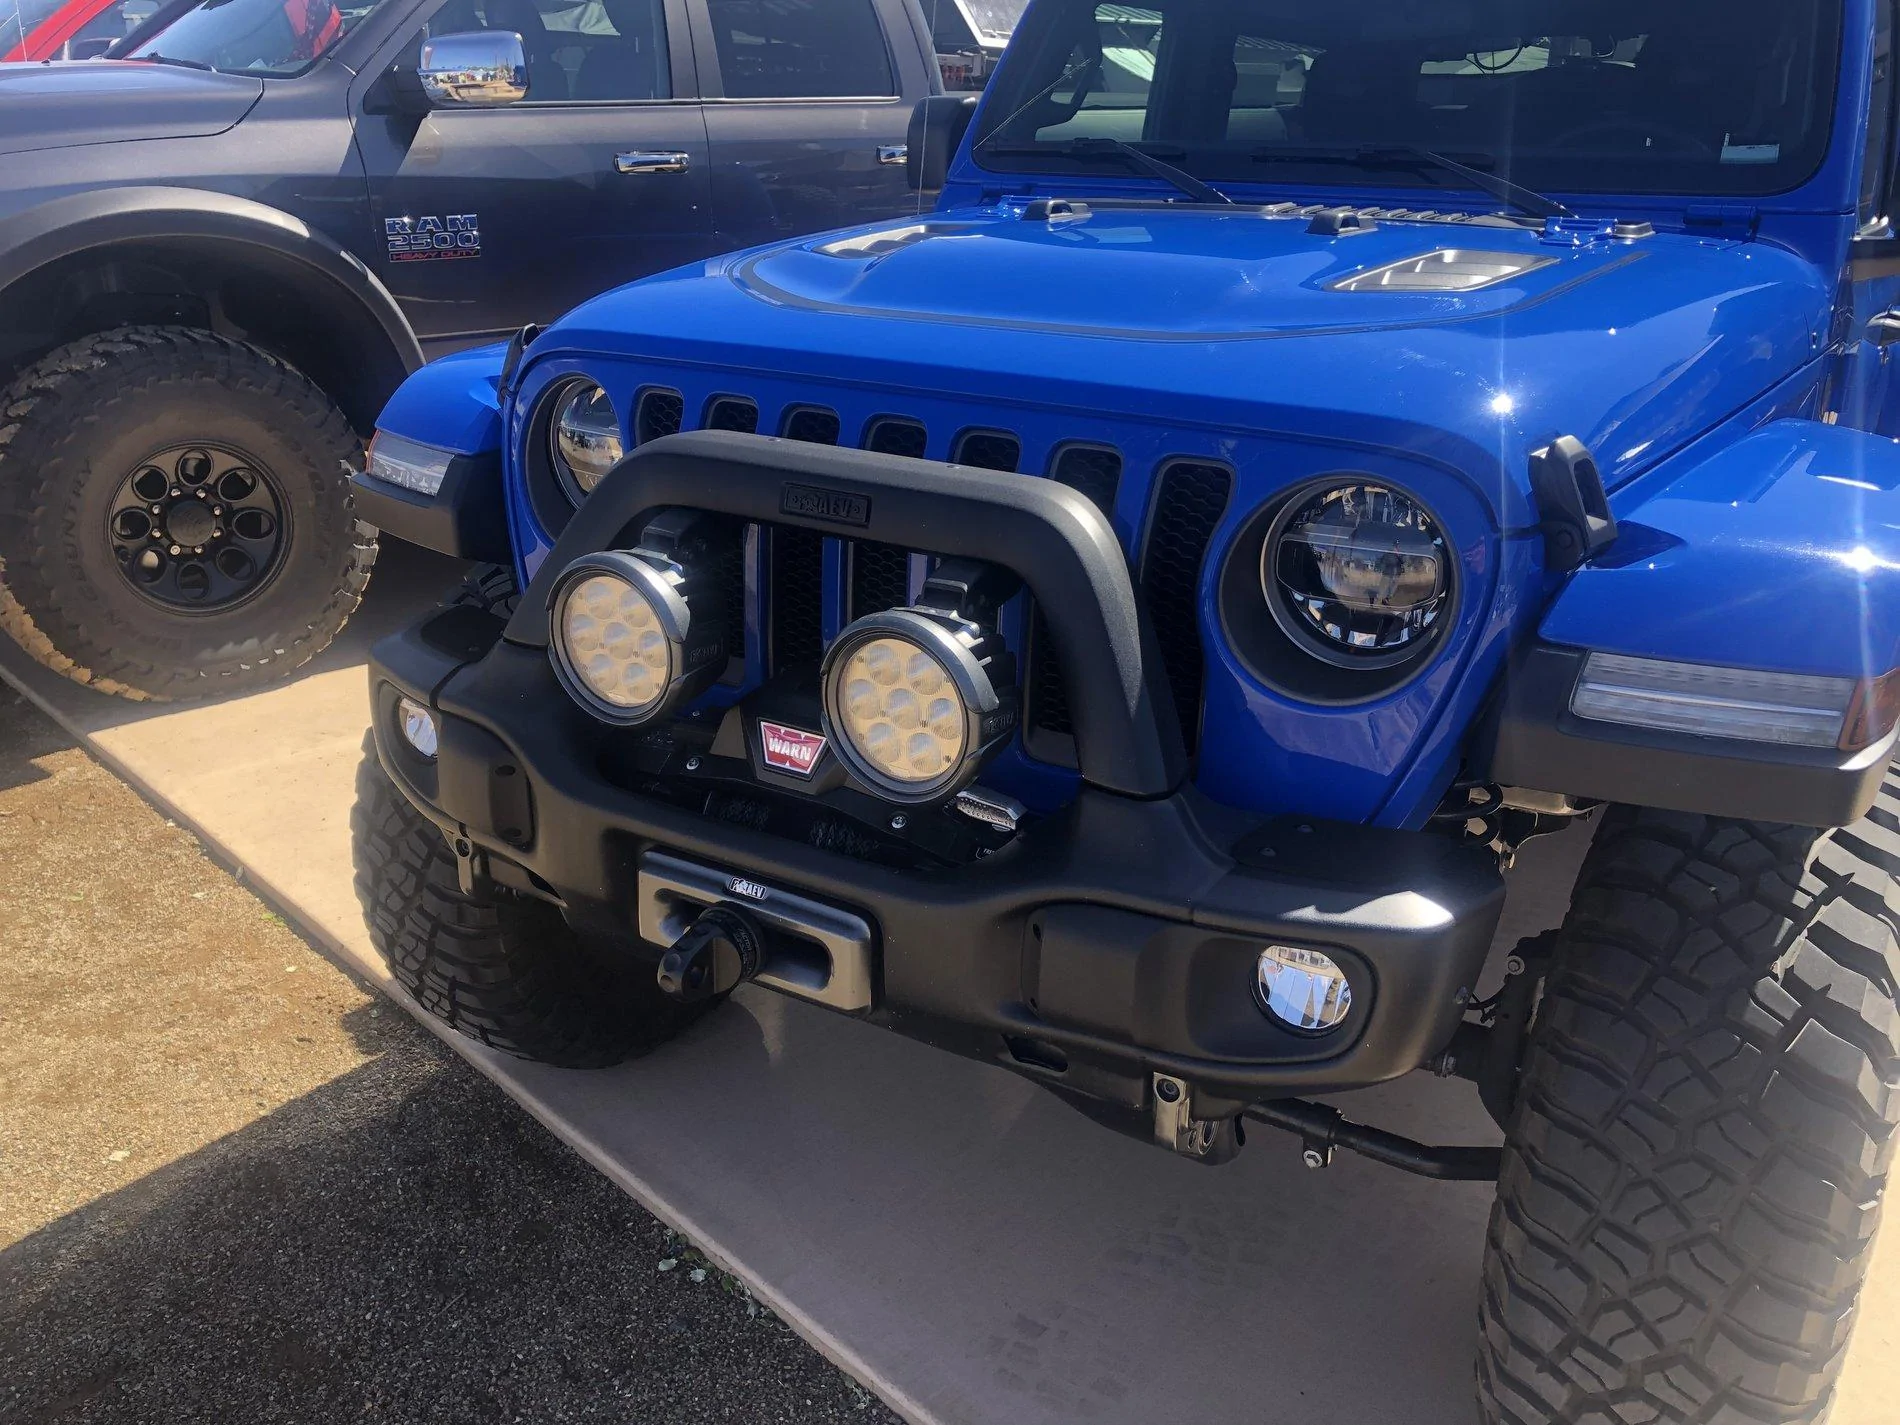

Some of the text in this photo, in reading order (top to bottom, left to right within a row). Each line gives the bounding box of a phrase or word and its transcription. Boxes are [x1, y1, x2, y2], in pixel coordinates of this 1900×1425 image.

[385, 214, 478, 234] RAM
[388, 231, 480, 251] 2500
[392, 249, 477, 260] HEAVY DUTY
[768, 737, 812, 761] WARN
